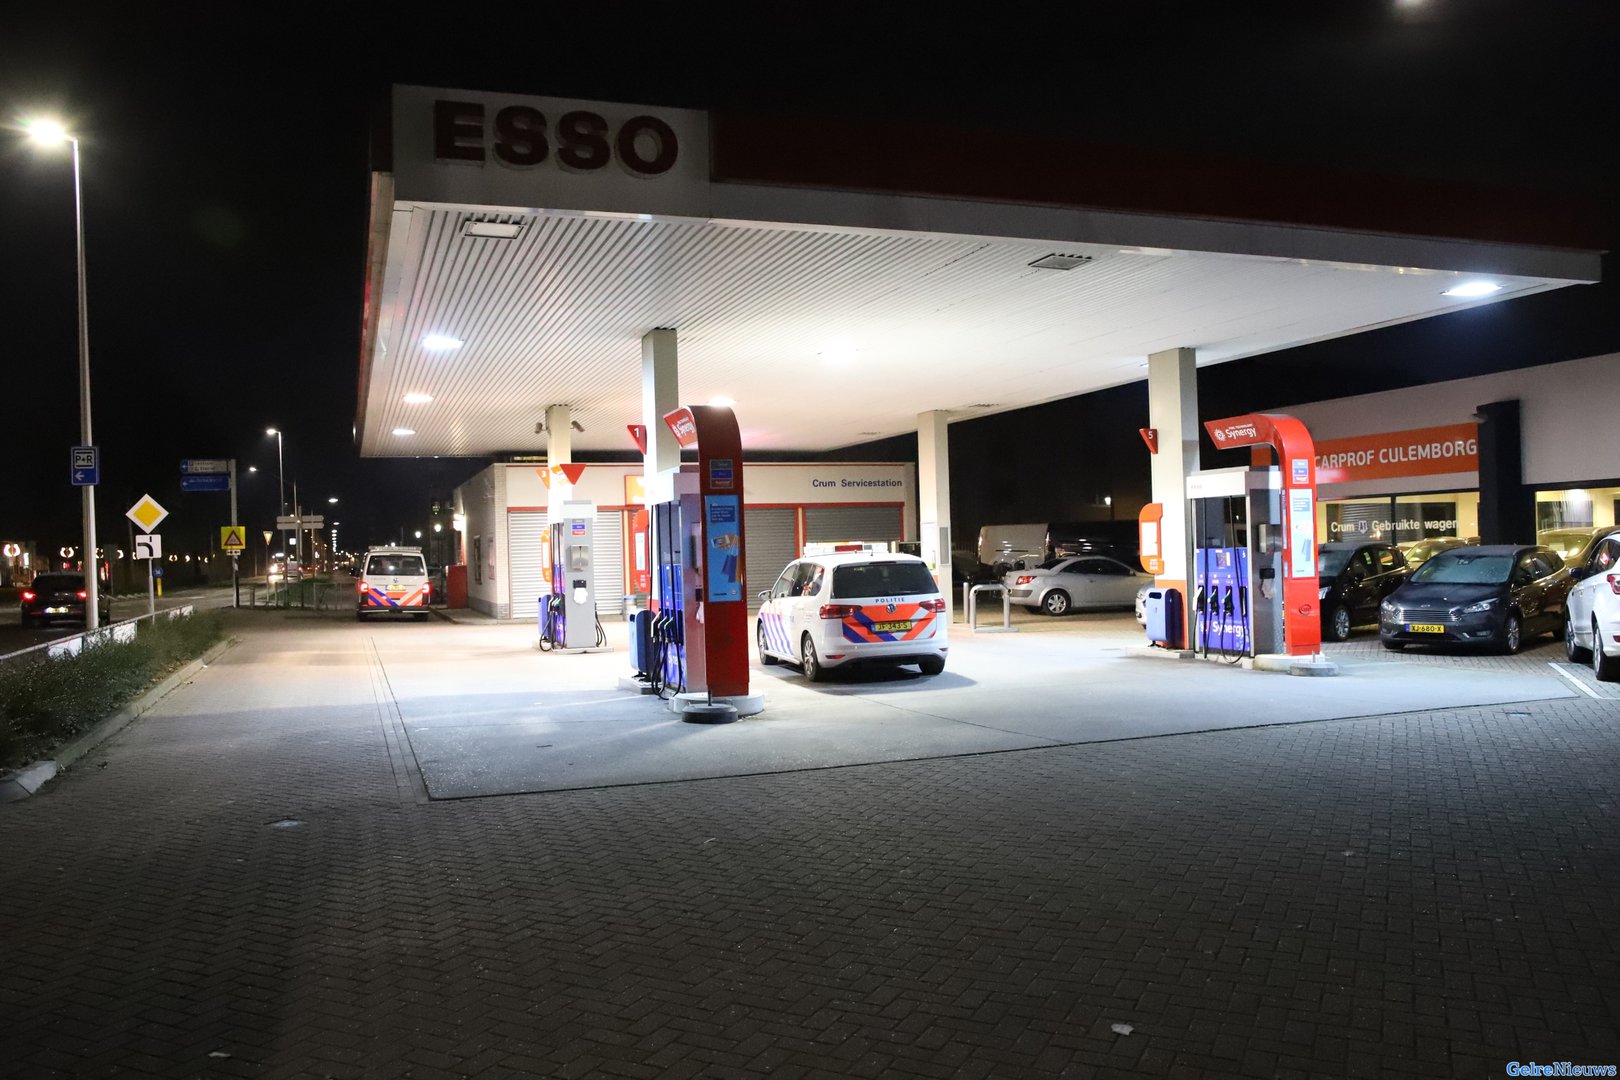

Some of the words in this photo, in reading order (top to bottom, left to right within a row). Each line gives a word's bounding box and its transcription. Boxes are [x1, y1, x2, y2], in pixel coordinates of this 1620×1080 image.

[433, 99, 679, 178] ESSO
[634, 427, 640, 438] 1
[1148, 430, 1153, 439] 5
[1225, 427, 1257, 440] Synergy
[1379, 439, 1477, 464] CULEMBORG
[76, 455, 93, 464] P+R
[812, 479, 836, 487] Crum
[841, 478, 902, 487] Servicestation
[1331, 521, 1355, 532] Crum
[1371, 519, 1420, 531] Gebruikte
